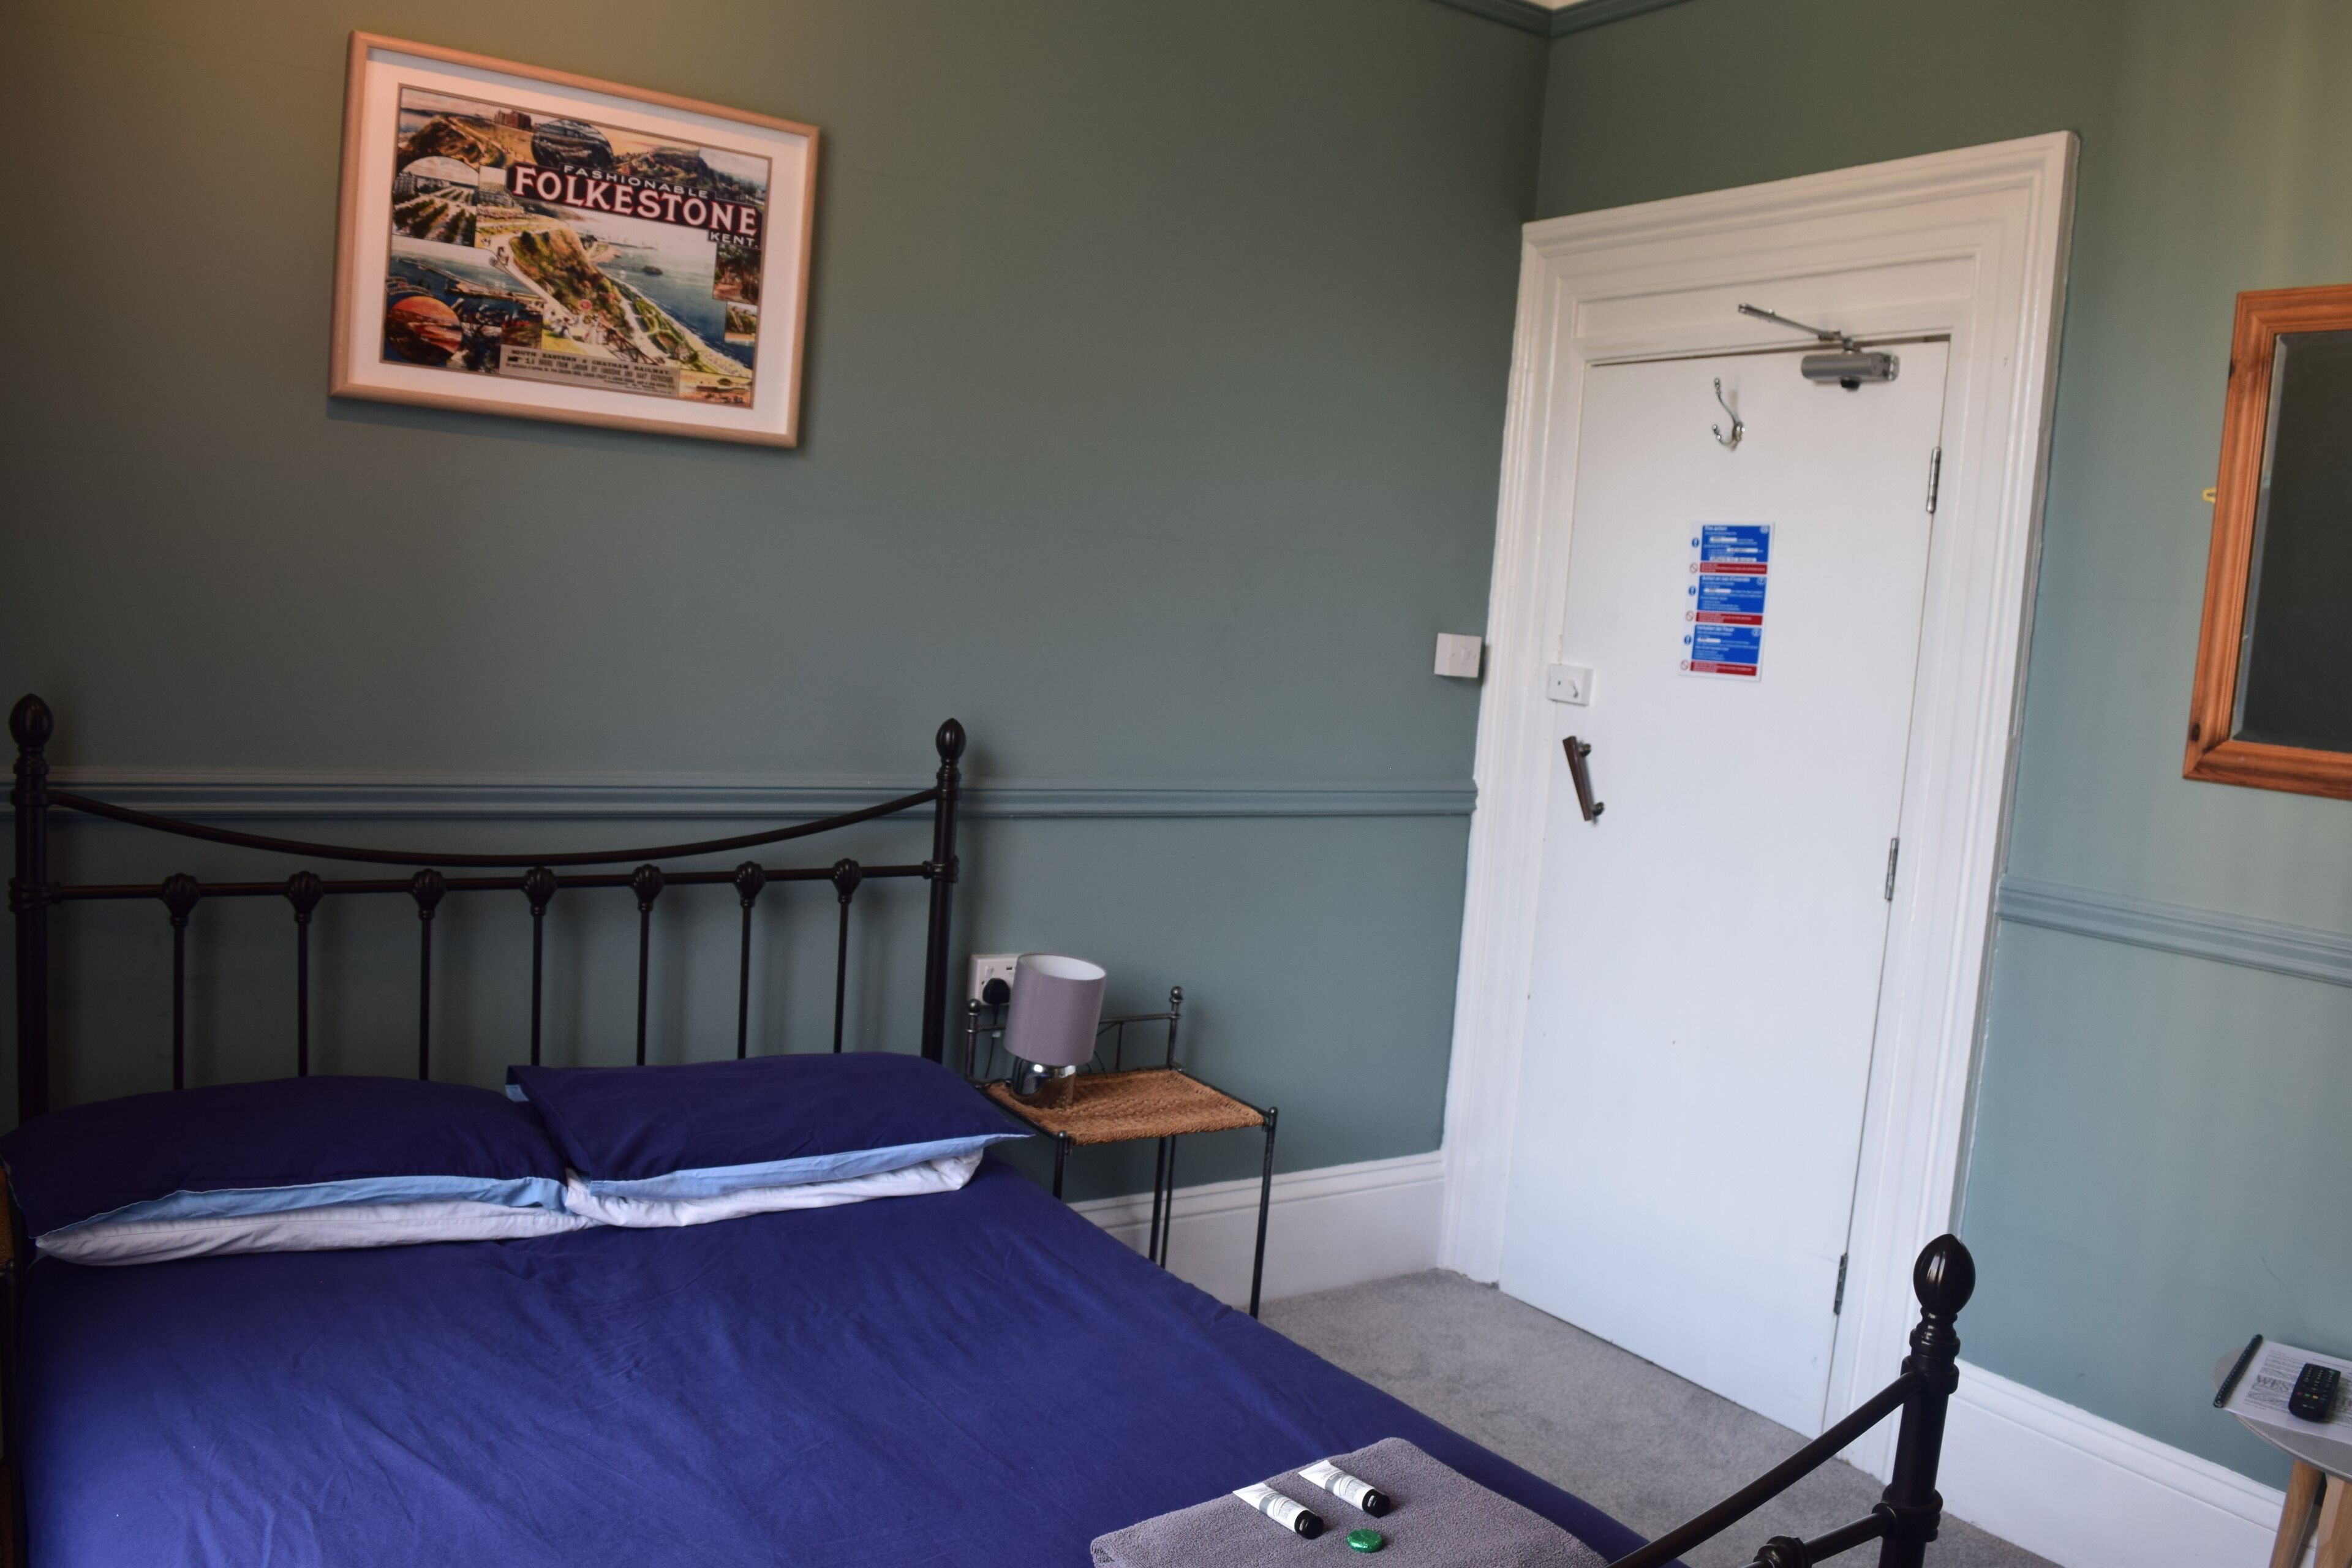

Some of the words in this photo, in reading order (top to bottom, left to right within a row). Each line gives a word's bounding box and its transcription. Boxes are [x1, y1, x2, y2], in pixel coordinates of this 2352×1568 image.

[563, 165, 709, 199] FASHIONABLE
[512, 165, 759, 238] FOLKESTONE
[709, 232, 758, 249] KENT.
[543, 353, 576, 361] EASTERN
[592, 360, 628, 369] CHATHAM
